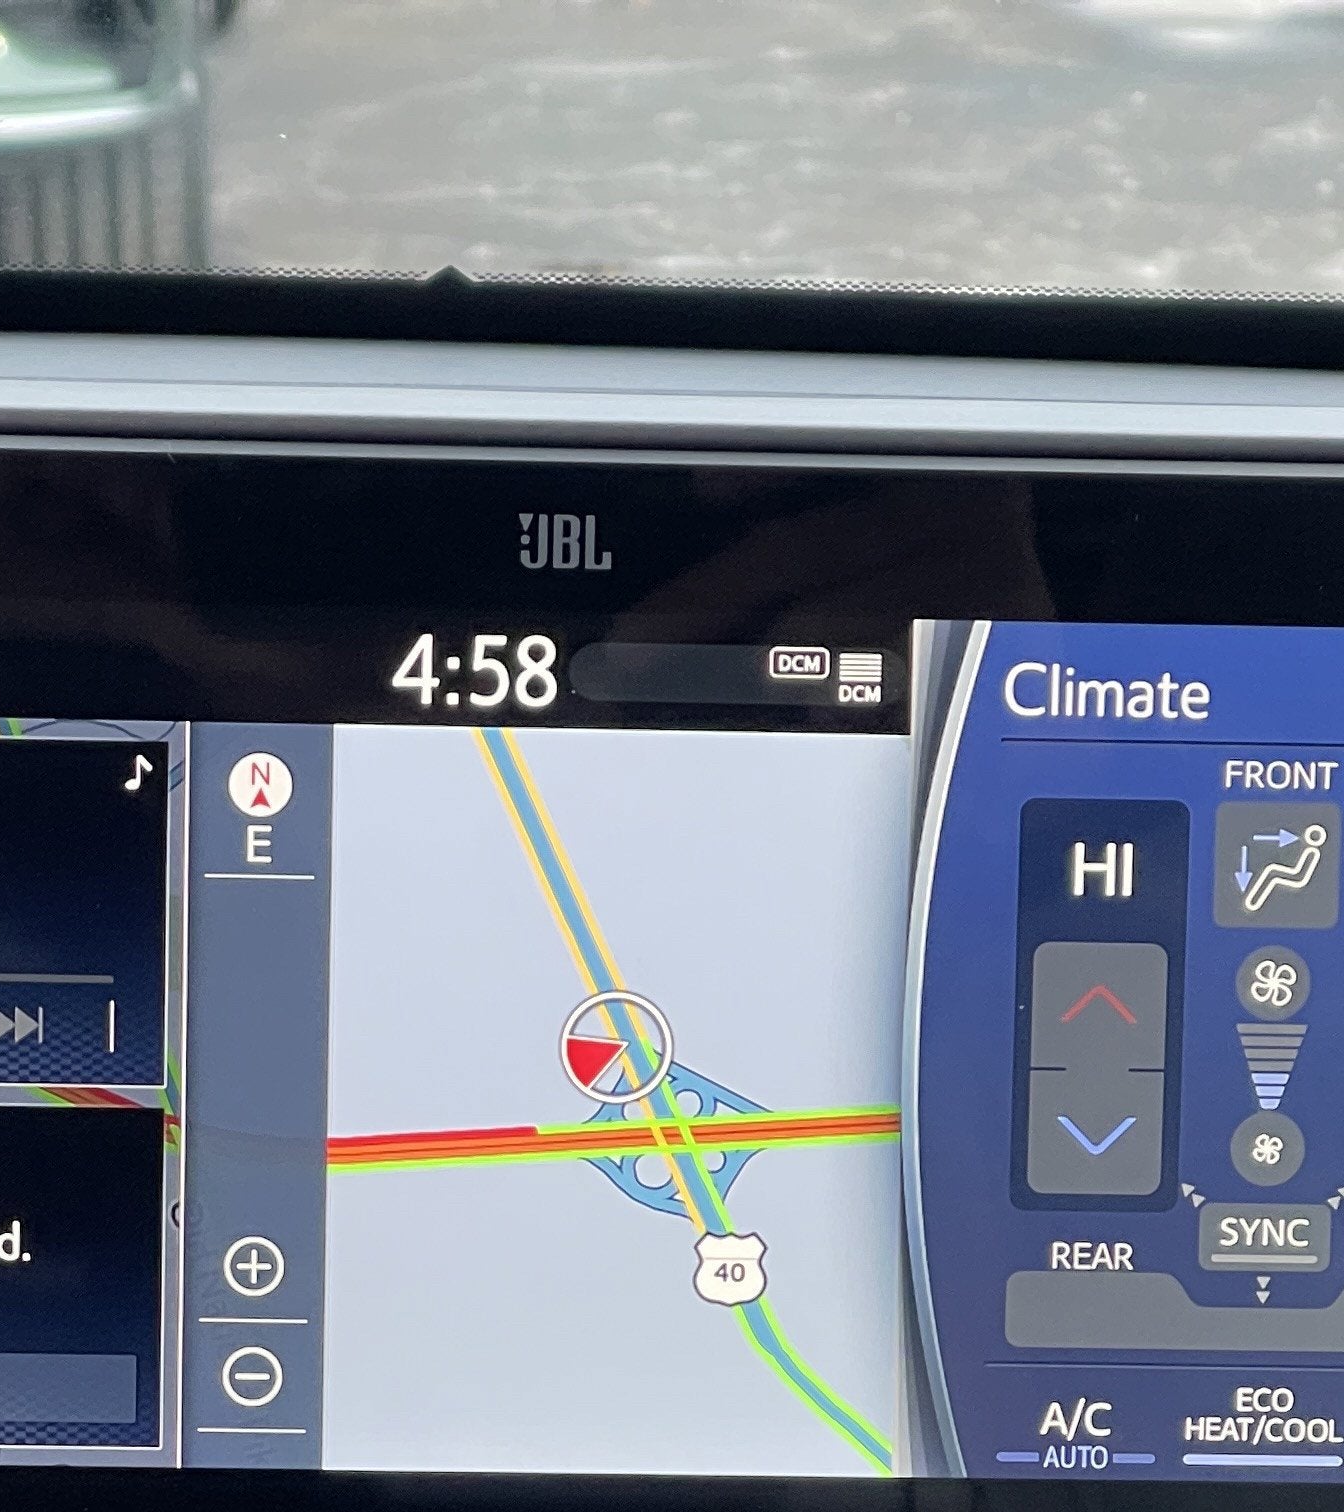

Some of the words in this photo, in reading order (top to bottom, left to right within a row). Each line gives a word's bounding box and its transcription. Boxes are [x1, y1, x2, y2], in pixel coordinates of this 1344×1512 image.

[518, 513, 612, 570] JBL
[391, 633, 558, 709] 4:58
[777, 653, 822, 675] DCM
[838, 684, 882, 703] DCM
[1004, 661, 1210, 720] Climate
[251, 762, 270, 786] N
[1225, 760, 1340, 790] FRONT
[246, 824, 273, 863] E
[1073, 841, 1134, 897] HI
[1219, 1216, 1310, 1248] SYNC
[1051, 1241, 1134, 1271] REAR
[713, 1262, 746, 1283] 40
[1236, 1386, 1295, 1413] ECO
[1039, 1397, 1112, 1442] A/C
[1184, 1414, 1344, 1445] HEAT/COOL
[1043, 1445, 1109, 1470] AUTO
